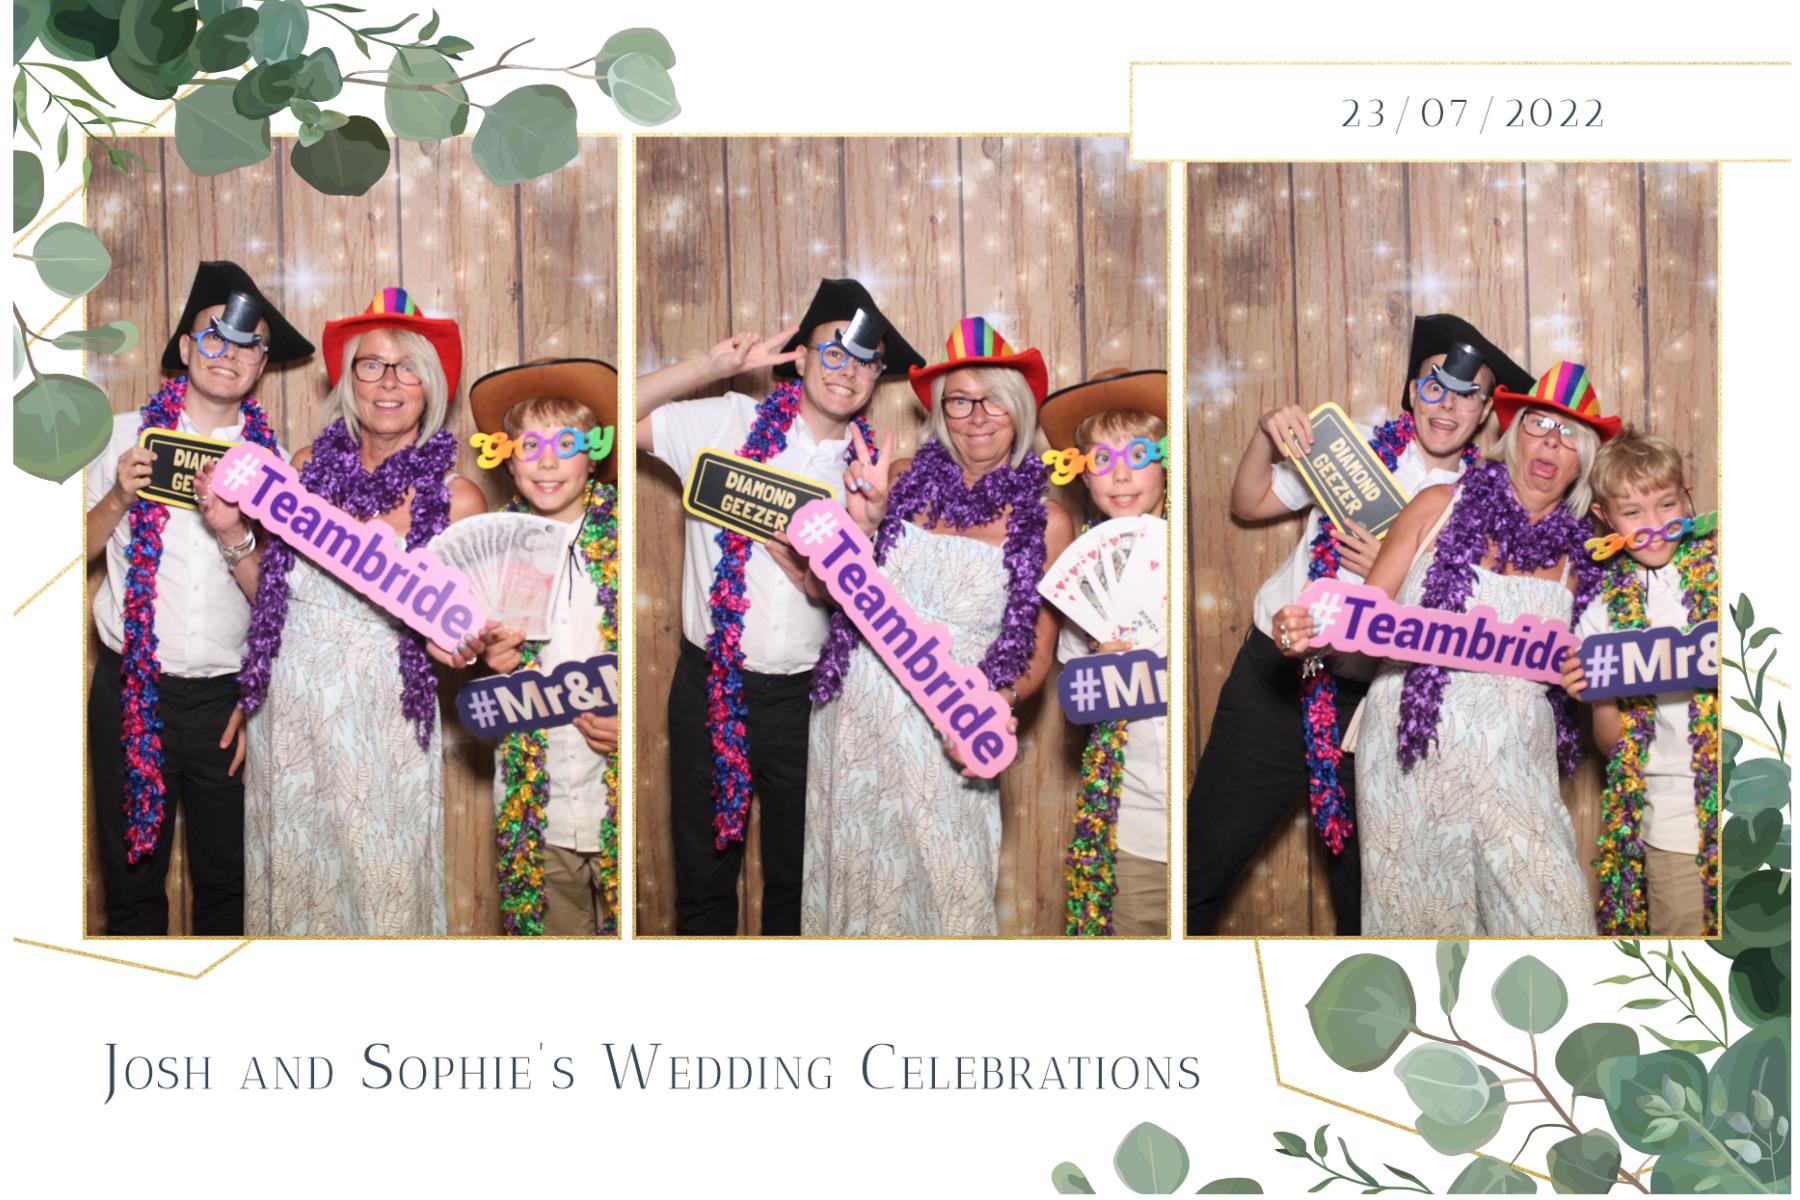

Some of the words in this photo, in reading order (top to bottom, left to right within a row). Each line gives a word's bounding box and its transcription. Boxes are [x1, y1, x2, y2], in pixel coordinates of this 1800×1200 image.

[173, 448, 220, 471] DIAM
[725, 471, 797, 510] DIAMOND
[1312, 453, 1363, 516] GEEZER
[1329, 437, 1381, 501] DIAMOND
[721, 494, 789, 531] GEEZER
[223, 453, 473, 640] #Teambride
[798, 511, 1004, 765] #Teambride
